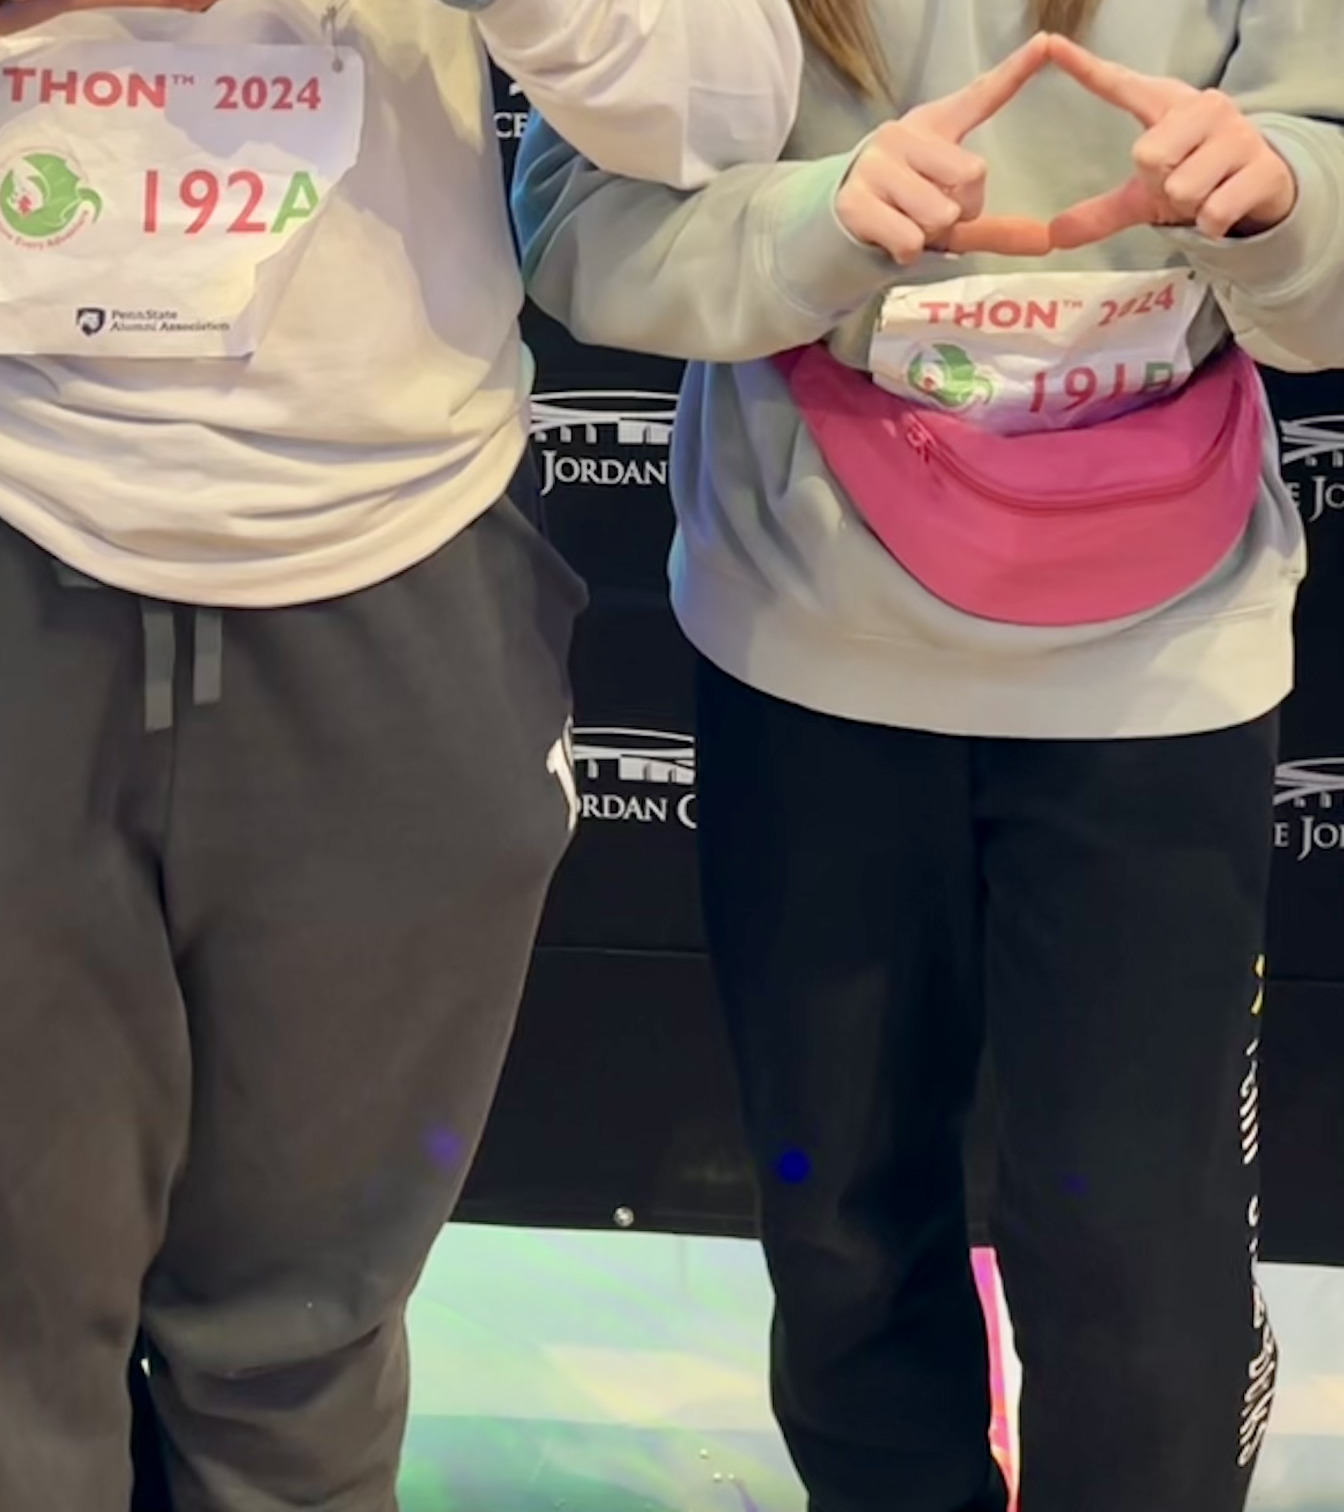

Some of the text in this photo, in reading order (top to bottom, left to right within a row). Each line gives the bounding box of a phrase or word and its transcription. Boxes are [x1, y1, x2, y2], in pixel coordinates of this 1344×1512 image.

[213, 76, 321, 110] 2024
[142, 169, 320, 235] 192A
[539, 449, 668, 497] JORDAN
[575, 793, 668, 822] RDAN
